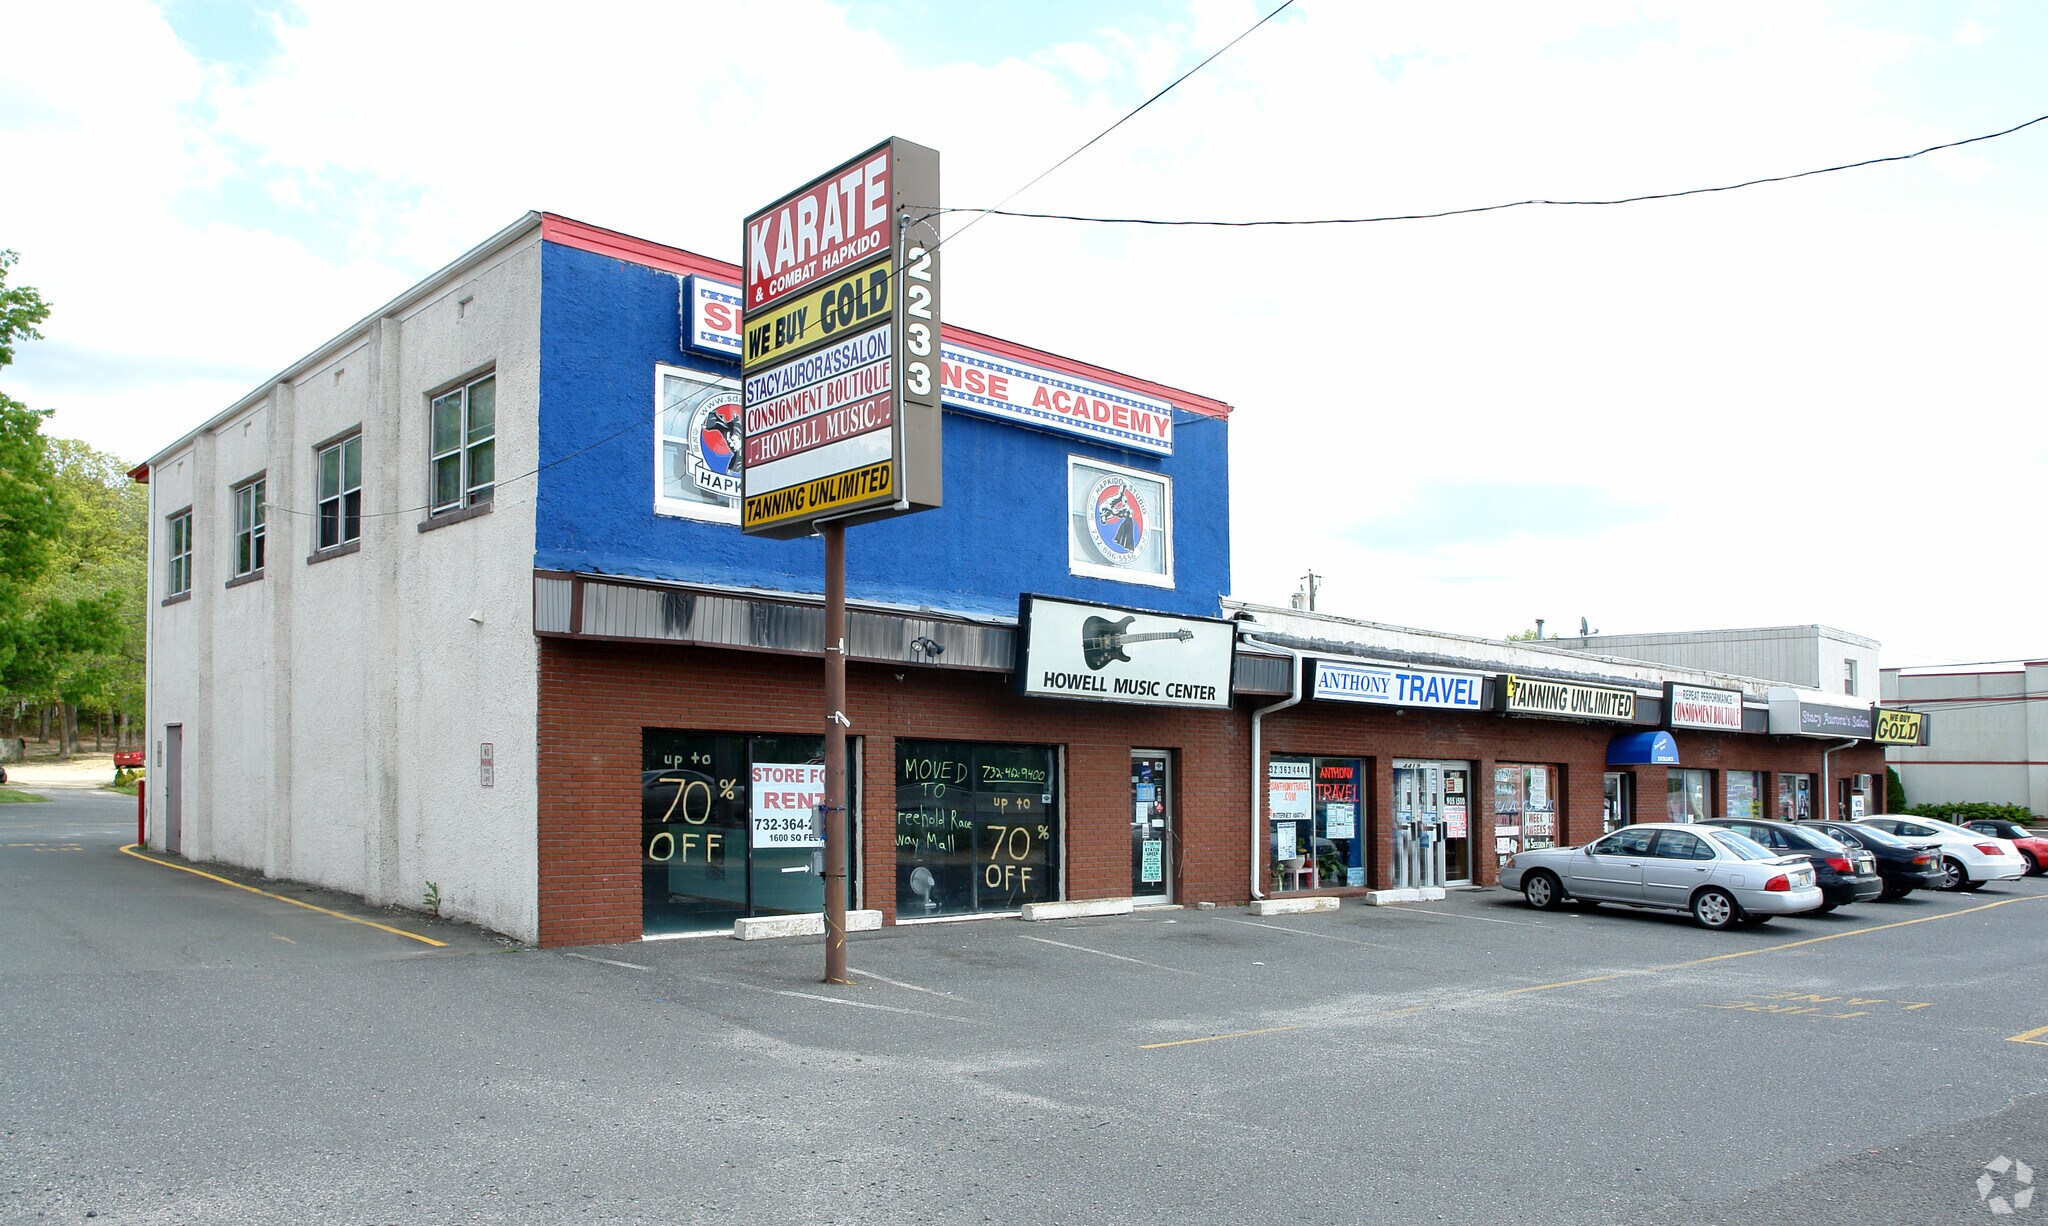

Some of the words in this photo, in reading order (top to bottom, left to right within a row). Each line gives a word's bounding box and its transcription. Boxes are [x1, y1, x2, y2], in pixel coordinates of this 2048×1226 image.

[750, 154, 887, 286] KARATE
[755, 286, 764, 303] &
[769, 260, 817, 296] COMBAT
[822, 230, 880, 271] HAPKIDO
[749, 322, 770, 360] WE
[776, 306, 808, 350] BUY
[820, 268, 888, 335] GOLD
[747, 385, 824, 433] CONSIGNMENT
[826, 361, 890, 407] BOUTIQUE
[1032, 386, 1170, 438] ACADEMY
[760, 419, 822, 461] HOWELL
[825, 402, 876, 440] MUSIC
[746, 486, 805, 522] TANNING
[808, 464, 890, 509] UNLIMITED
[1043, 671, 1108, 693] HOWELL
[1113, 677, 1161, 697] MUSIC
[1165, 682, 1216, 701] CENTER
[1318, 671, 1391, 694] ANTHONY
[1395, 673, 1479, 706] TRAVEL
[1512, 681, 1568, 711] TANNING
[1570, 688, 1632, 717] UNLIMITED
[1682, 689, 1700, 700] REPEAT
[1700, 691, 1733, 705] PERFORMANCE
[1673, 701, 1713, 723] CONSIGNMENT
[1713, 705, 1740, 727] BOUTIQUE
[1801, 710, 1822, 728] Stacy
[1823, 712, 1851, 728] Aurora's
[1889, 713, 1899, 722] WE
[1899, 713, 1911, 723] BUY
[1877, 717, 1919, 740] GOLD
[664, 754, 683, 770] up
[691, 751, 712, 766] to
[905, 758, 968, 784] MOVED
[1319, 767, 1354, 779] ANTHONY
[752, 767, 805, 783] STORE
[920, 782, 946, 799] TO
[1315, 783, 1360, 802] TRAVEL
[993, 797, 1009, 815] up
[1016, 797, 1031, 811] to
[951, 809, 973, 831] Race
[649, 832, 722, 863] OFF
[769, 833, 788, 842] 1600
[790, 833, 802, 842] SQ
[926, 831, 956, 857] Mall
[985, 863, 1033, 894] OFF
